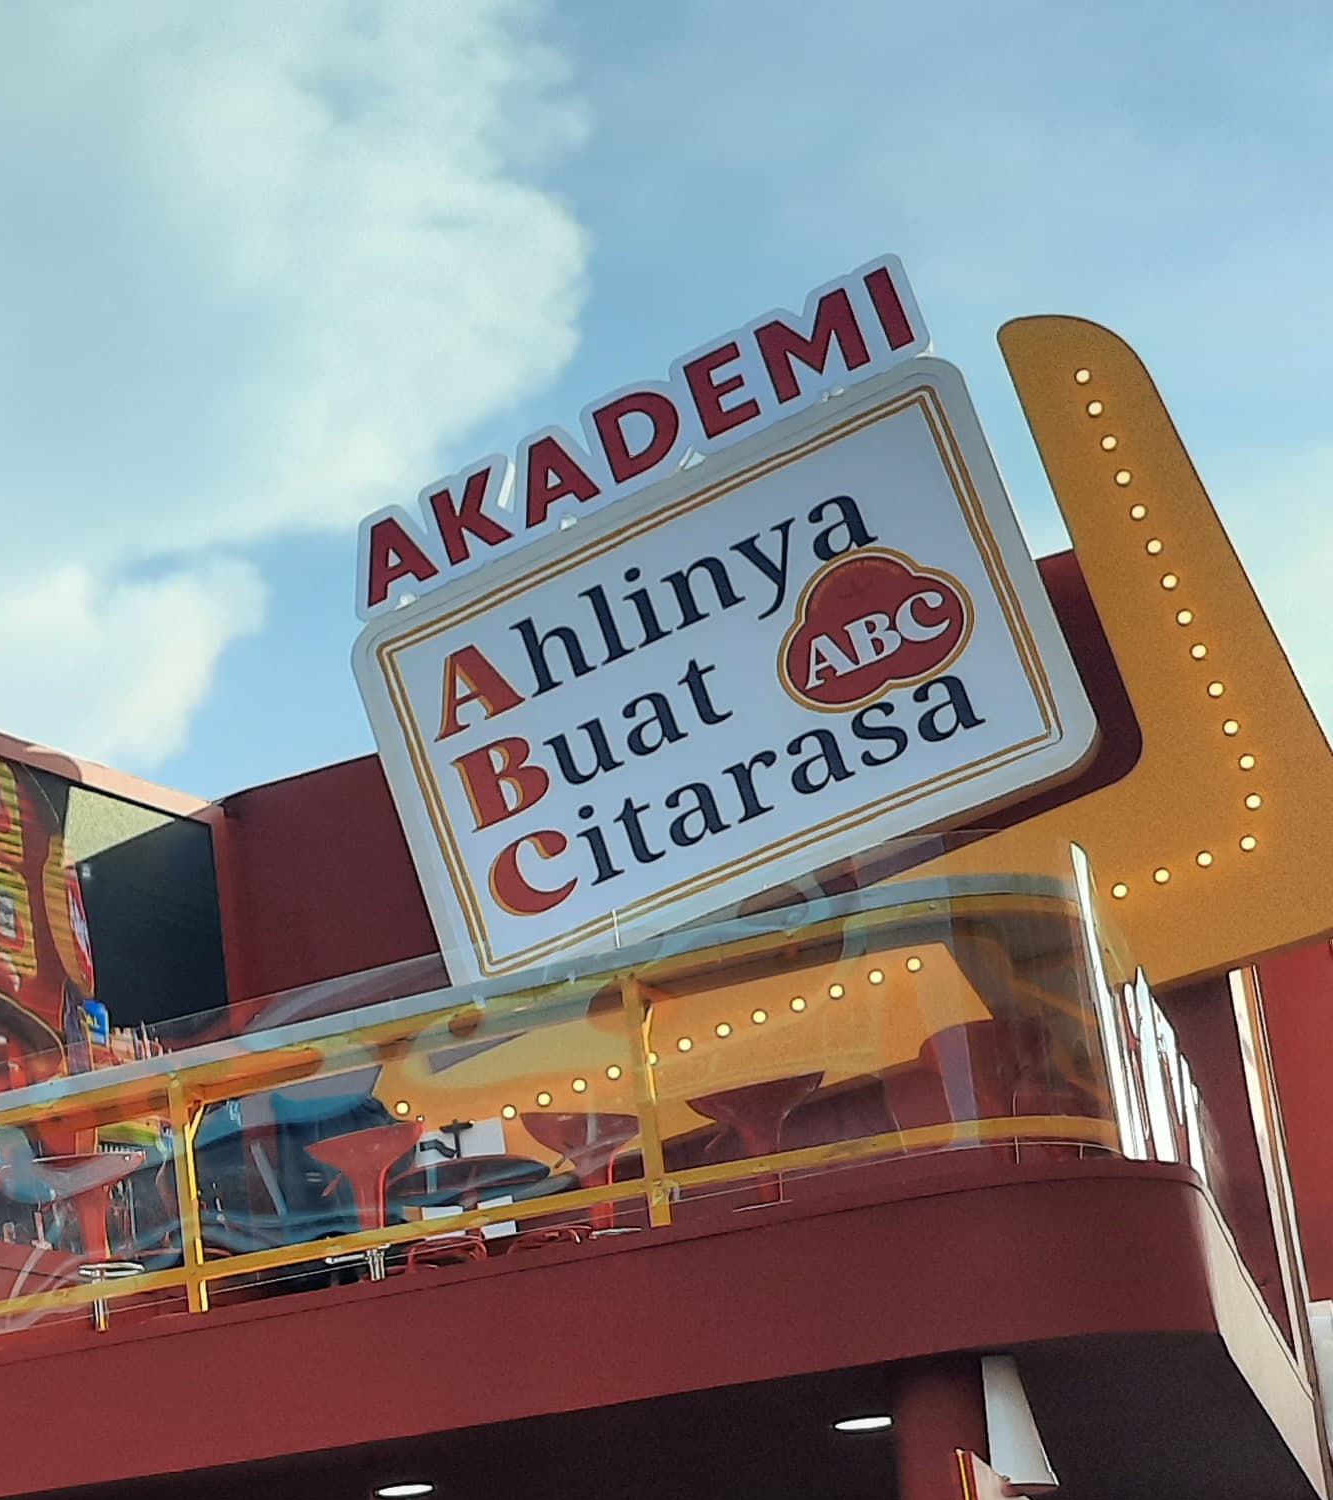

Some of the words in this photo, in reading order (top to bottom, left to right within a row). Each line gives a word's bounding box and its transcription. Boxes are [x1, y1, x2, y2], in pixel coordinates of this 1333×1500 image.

[367, 266, 915, 609] AKADEMI
[435, 495, 878, 742] Ahlinya
[805, 590, 951, 691] ABC
[450, 657, 734, 832] Buat
[487, 674, 986, 917] Citarasa
